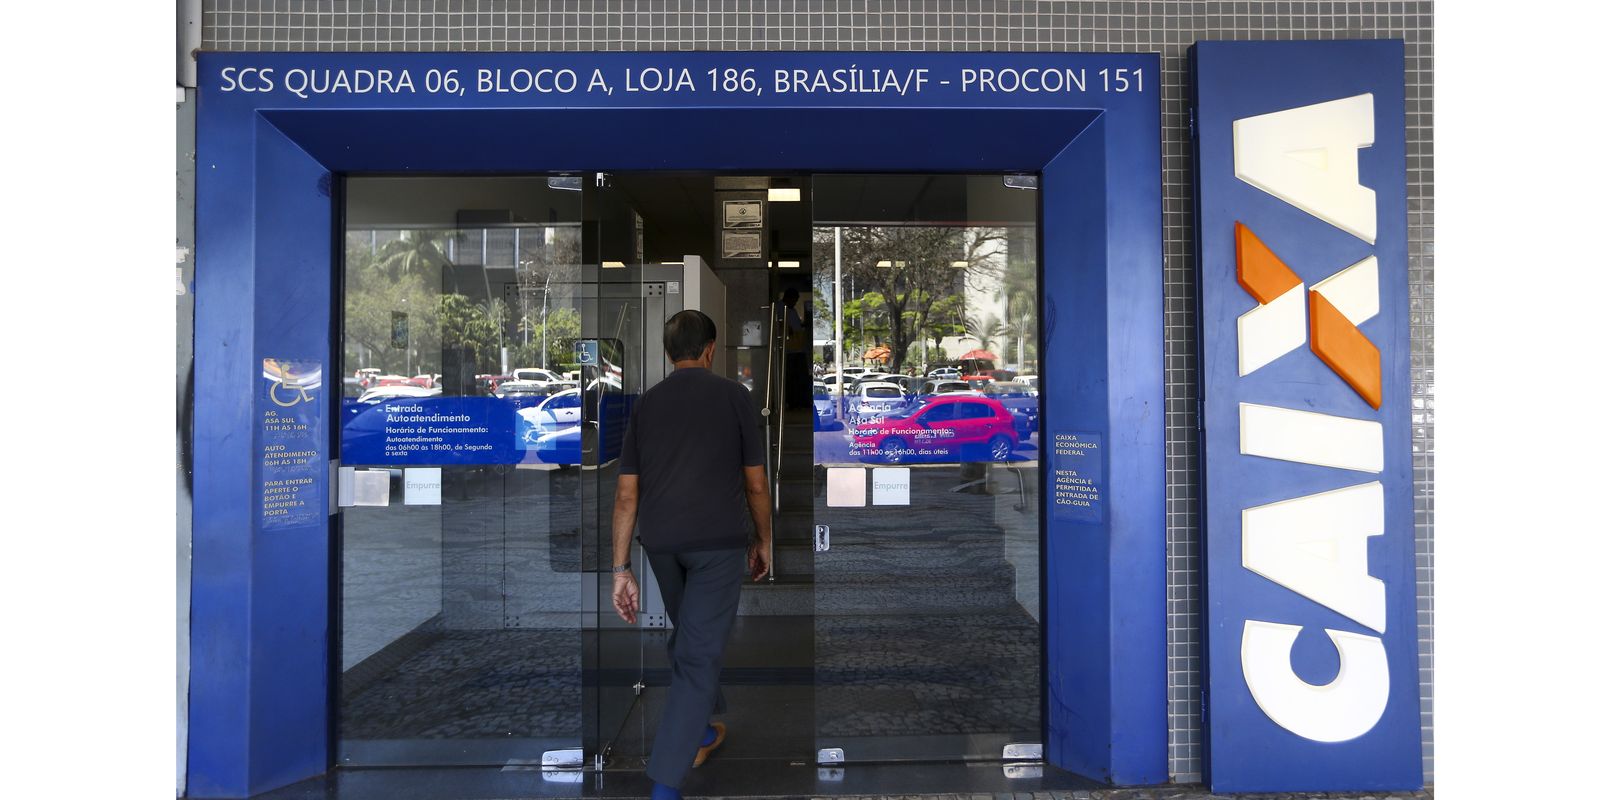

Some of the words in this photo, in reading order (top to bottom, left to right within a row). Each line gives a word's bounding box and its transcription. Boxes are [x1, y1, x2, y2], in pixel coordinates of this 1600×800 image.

[220, 67, 274, 92] SCS
[284, 69, 415, 98] QUADRA
[425, 69, 466, 96] 06,
[477, 69, 578, 93] BLOCO
[588, 69, 614, 95] A,
[625, 68, 696, 93] LOJA
[707, 69, 762, 95] 186,
[774, 64, 929, 95] BRASÍLIA/F
[961, 69, 1087, 92] PROCON
[1099, 69, 1144, 92] 151
[385, 404, 423, 413] Entrada
[386, 413, 471, 422] Autoatendimento
[849, 416, 868, 425] Asa
[870, 416, 885, 424] Sul
[1232, 92, 1391, 743] CAIXA
[385, 426, 415, 434] Horário
[416, 426, 427, 434] de
[428, 426, 489, 434] Funcionamento:
[848, 427, 878, 435] Horário
[891, 426, 952, 435] Funcionamento:
[430, 444, 453, 452] 18h00,
[464, 443, 493, 452] Segunda
[849, 441, 876, 449] Agência
[265, 450, 317, 459] ATENDIMENTO
[406, 480, 441, 492] Empurre
[874, 481, 908, 492] Empurre
[1055, 484, 1092, 492] PERMITIDA
[264, 487, 291, 495] APERTE
[264, 501, 298, 509] EMPURRE
